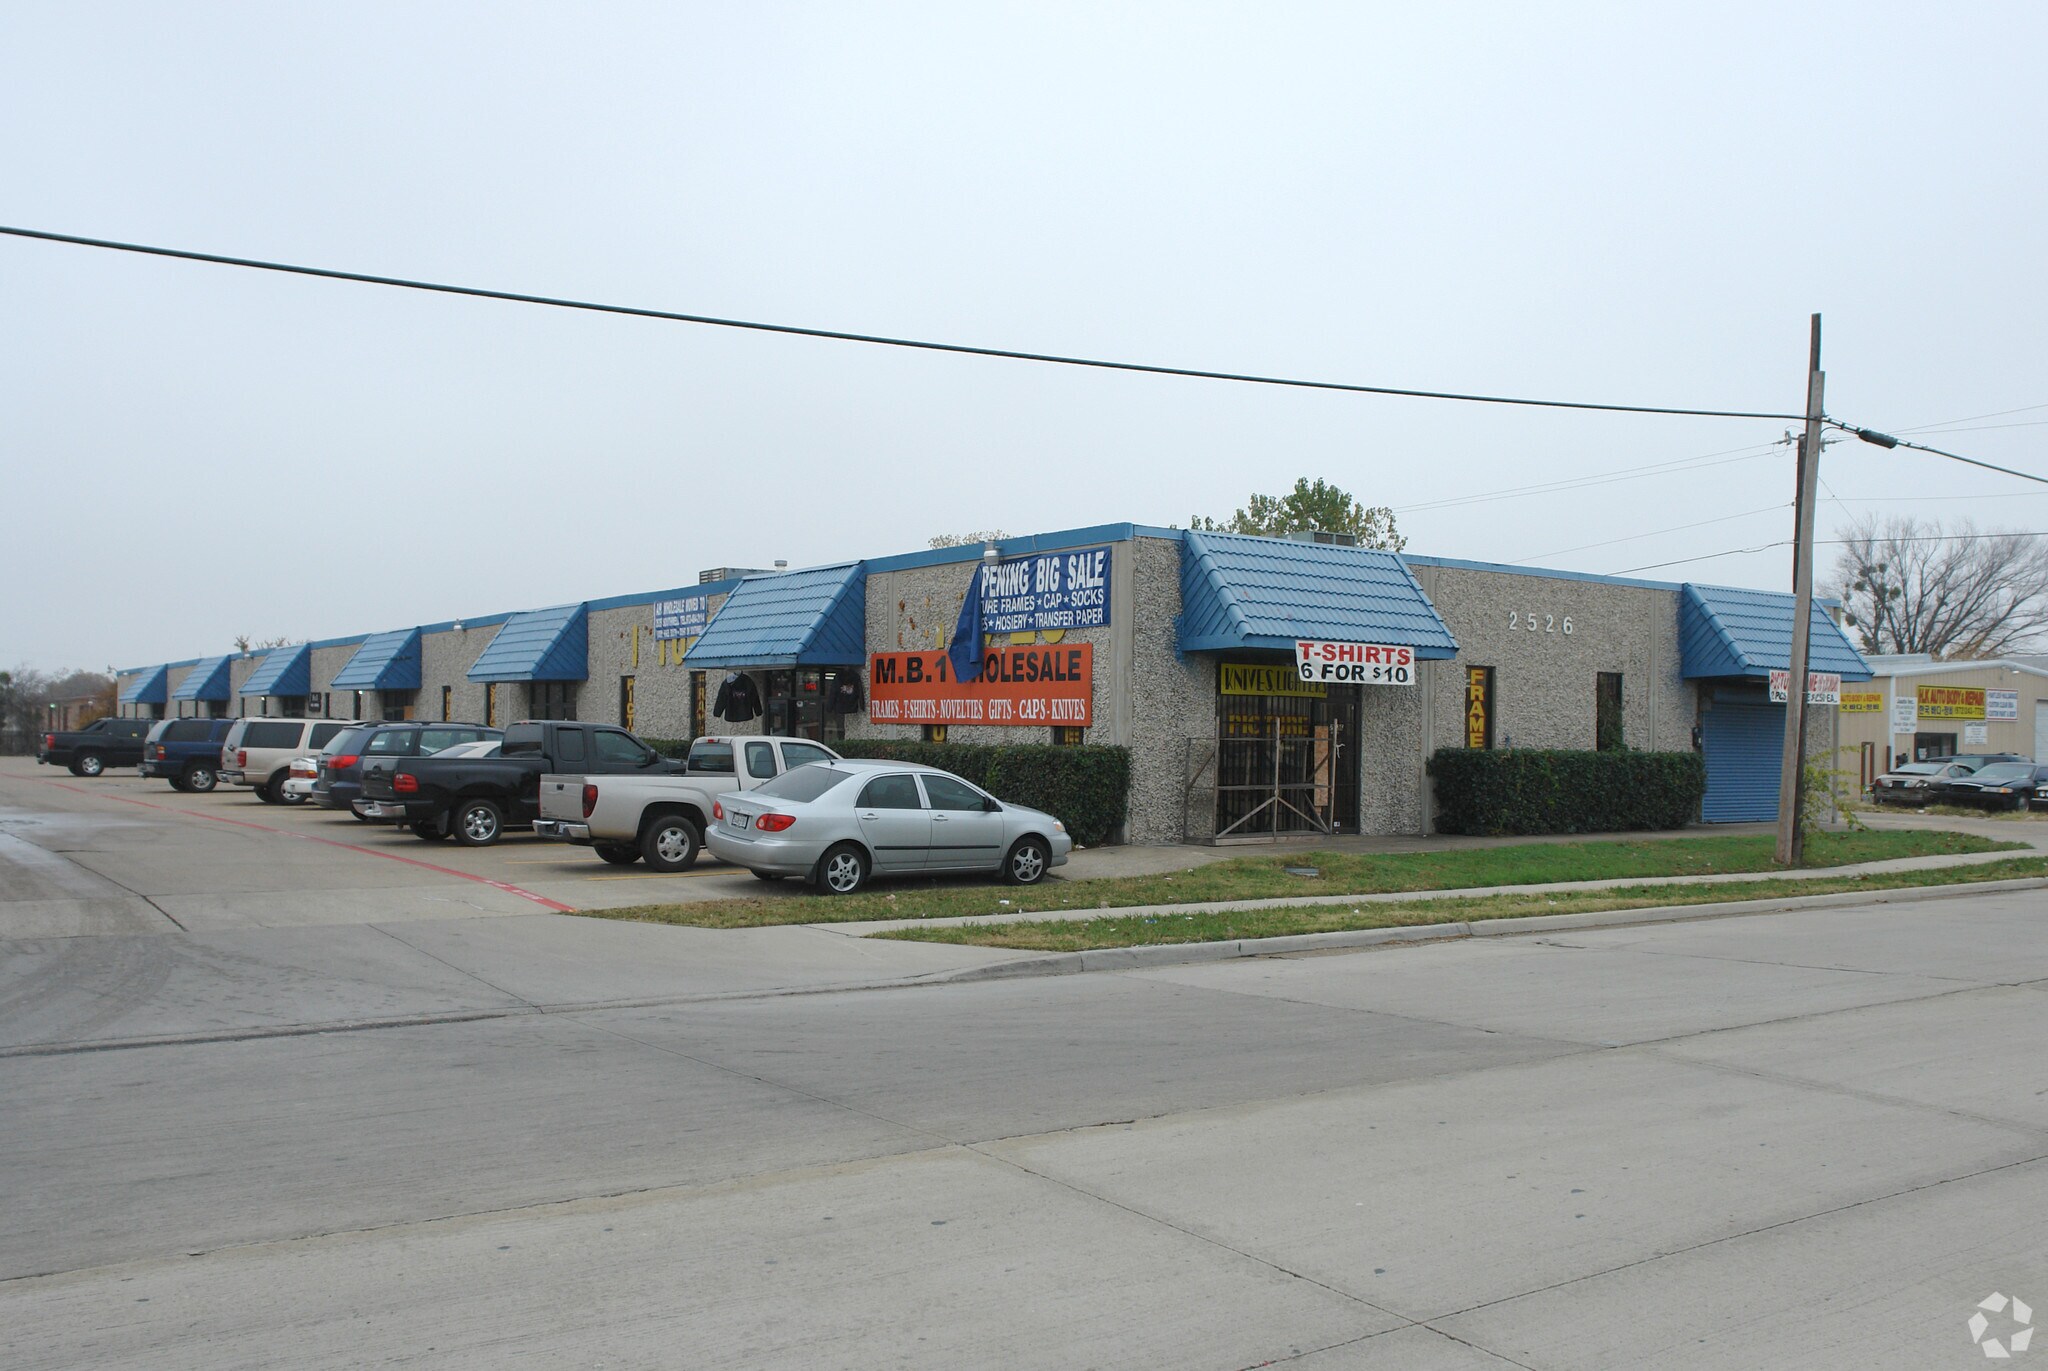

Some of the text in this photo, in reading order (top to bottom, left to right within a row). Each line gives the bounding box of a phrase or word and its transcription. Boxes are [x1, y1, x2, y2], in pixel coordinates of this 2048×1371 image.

[981, 551, 1105, 598] PENING BIG SALE
[981, 588, 1104, 615] URE FRAMES CAP SOCKS
[994, 613, 1028, 631] HOSIERY
[1035, 610, 1074, 628] TRANSFER
[1076, 607, 1104, 625] PAPER
[1508, 611, 1574, 635] 2526
[1298, 642, 1411, 666] T-SHIRTS
[970, 650, 1082, 683] OLESALE
[1301, 662, 1409, 683] 6 FOR $10
[871, 699, 900, 719] FRAMES
[940, 699, 983, 719] NOVELTIES
[988, 699, 1012, 720] GIFTS
[1019, 698, 1046, 720] CAPS
[1051, 698, 1086, 720] KNIVES
[1469, 669, 1485, 749] FRAME
[1930, 688, 1946, 704] AUTO
[1947, 690, 1961, 705] BODY
[1965, 691, 1985, 706] REPAIR
